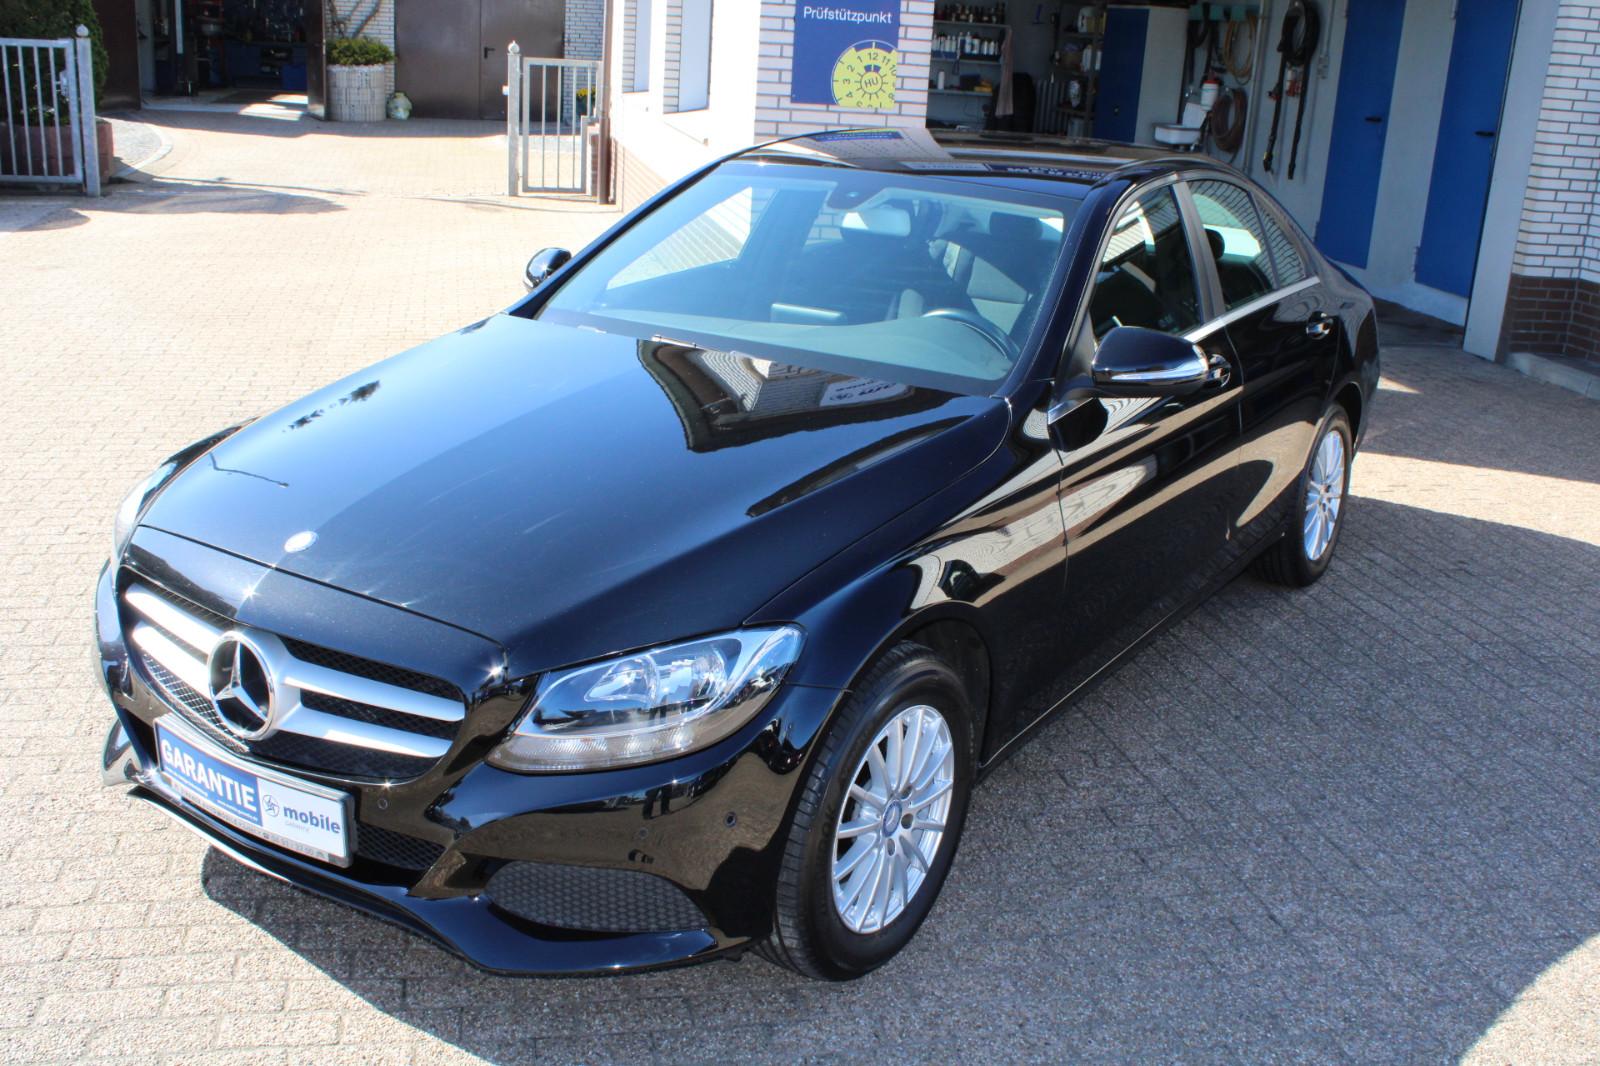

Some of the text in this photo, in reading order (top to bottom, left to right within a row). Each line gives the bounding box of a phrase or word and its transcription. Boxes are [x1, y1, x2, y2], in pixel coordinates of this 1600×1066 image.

[804, 6, 892, 24] Prüfstützpunkt
[867, 52, 879, 61] 12
[882, 55, 890, 66] 11
[847, 64, 855, 73] 2
[864, 76, 879, 88] HU
[160, 739, 257, 812] GARANTIE
[283, 806, 341, 834] mobile
